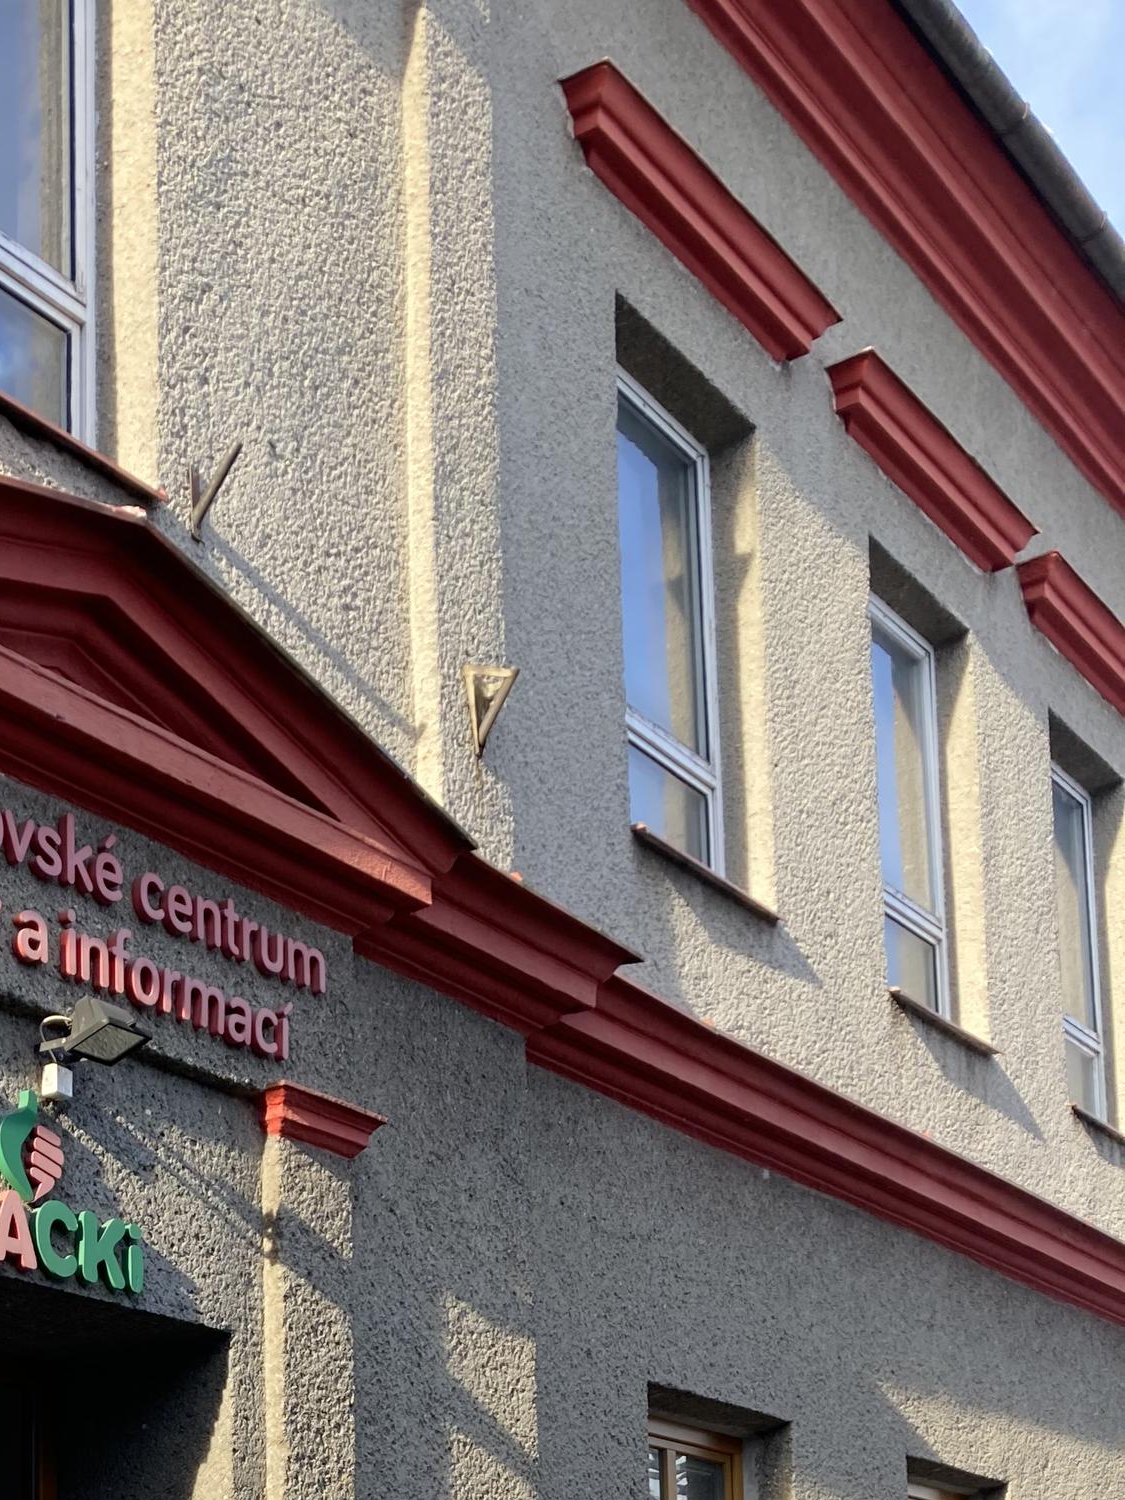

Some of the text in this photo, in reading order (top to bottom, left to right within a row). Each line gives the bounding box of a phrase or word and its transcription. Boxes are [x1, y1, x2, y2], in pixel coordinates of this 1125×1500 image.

[14, 910, 50, 965] a
[60, 910, 296, 1061] informací
[132, 869, 328, 995] centrum
